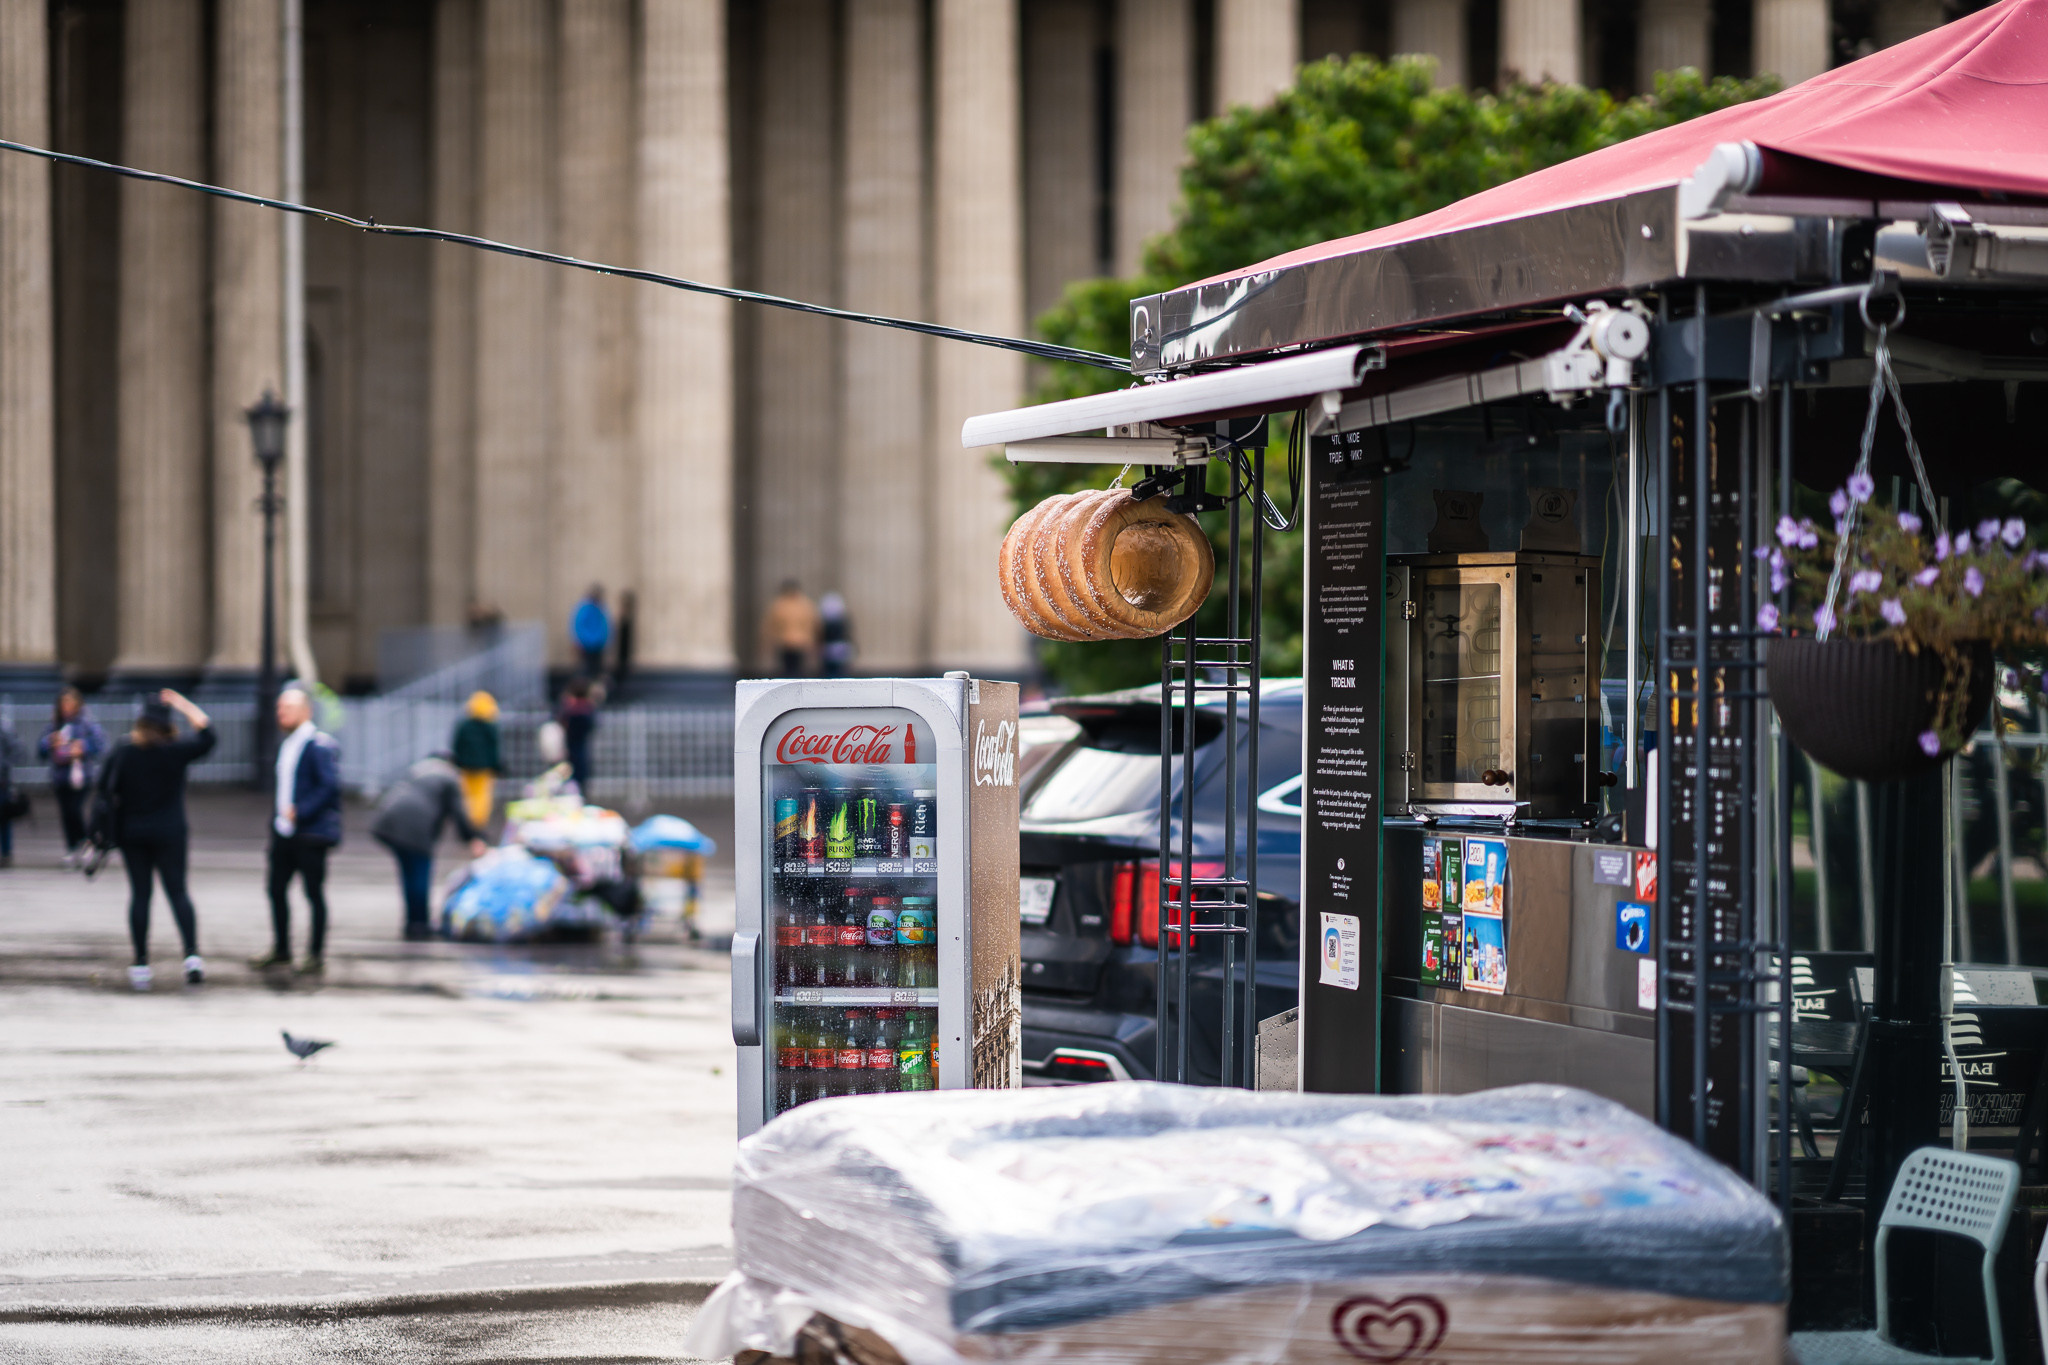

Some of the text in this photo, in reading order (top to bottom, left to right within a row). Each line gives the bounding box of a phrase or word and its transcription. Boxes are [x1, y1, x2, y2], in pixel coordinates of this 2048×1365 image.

[1332, 660, 1355, 671] WHAT IS
[1330, 676, 1356, 688] TRDELNIK
[776, 725, 898, 764] Coca-Cola
[975, 719, 1016, 786] Coca-Cola
[915, 804, 927, 834] Rich
[828, 845, 851, 853] BURN
[891, 825, 899, 859] NERGY
[840, 930, 865, 941] Coca-Cola
[894, 991, 907, 1002] 80
[901, 1054, 923, 1074] Sprite
